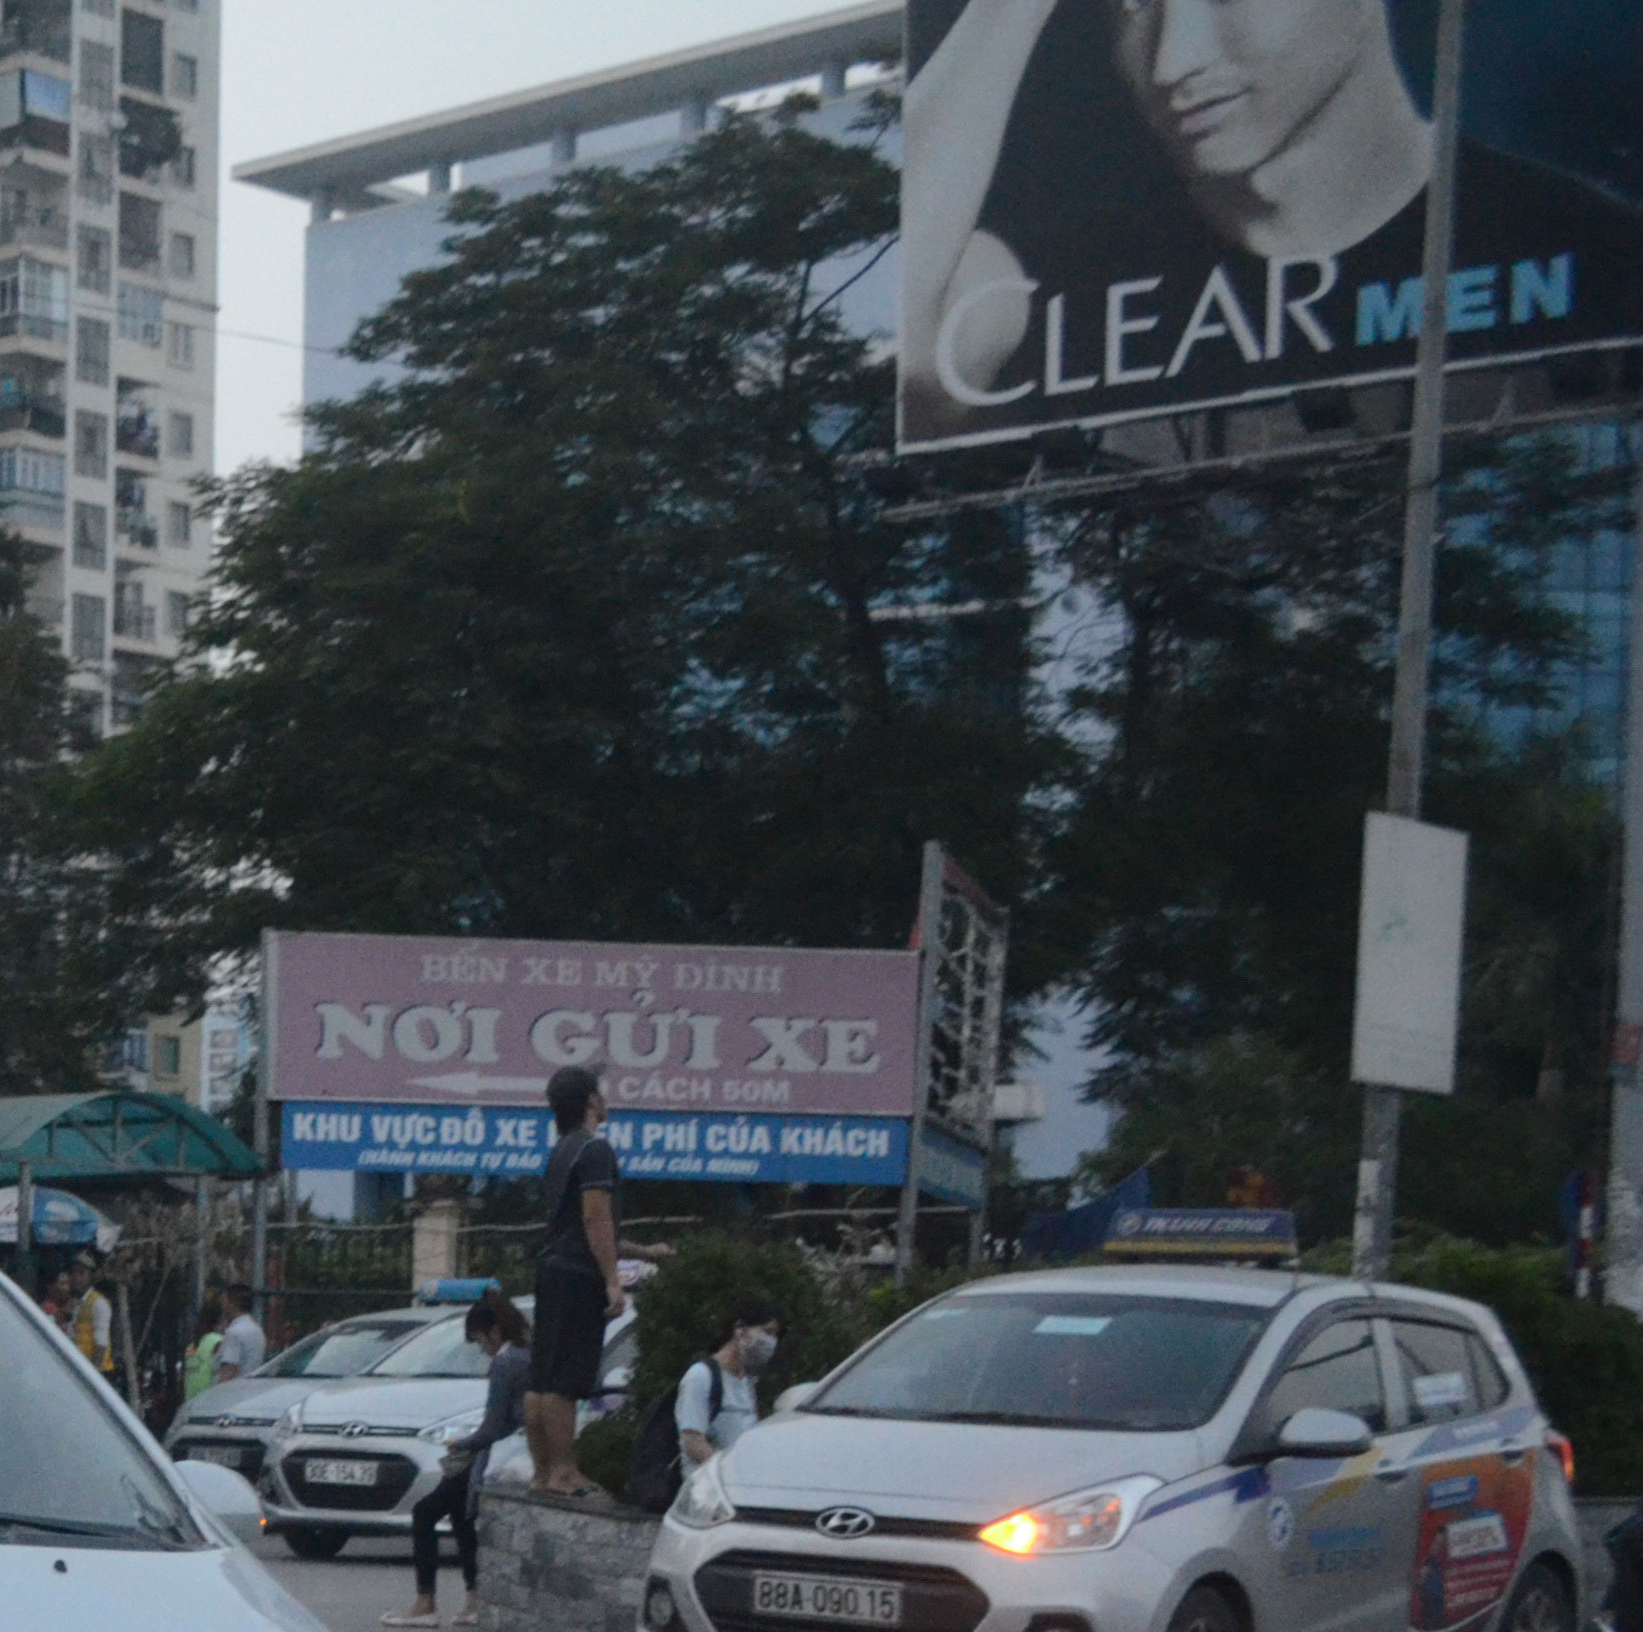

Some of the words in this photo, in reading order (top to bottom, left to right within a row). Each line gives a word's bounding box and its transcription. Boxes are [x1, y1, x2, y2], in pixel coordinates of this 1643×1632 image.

[935, 255, 1337, 406] CLEAR
[1355, 252, 1575, 347] MEN
[421, 947, 507, 985] BẾN
[521, 958, 582, 988] XE
[593, 954, 660, 989] MỸ
[673, 961, 783, 993] ĐÌNH
[314, 1000, 503, 1064] NƠI
[529, 990, 722, 1071] GỬI
[746, 1016, 881, 1074] XE
[616, 1070, 712, 1103] CÁCH
[292, 1113, 361, 1143] KHU
[371, 1110, 439, 1149] VỰC
[494, 1118, 538, 1148] XE
[642, 1115, 699, 1153] PHÍ
[707, 1112, 771, 1154] CỦA
[780, 1114, 889, 1157] KHÁCH
